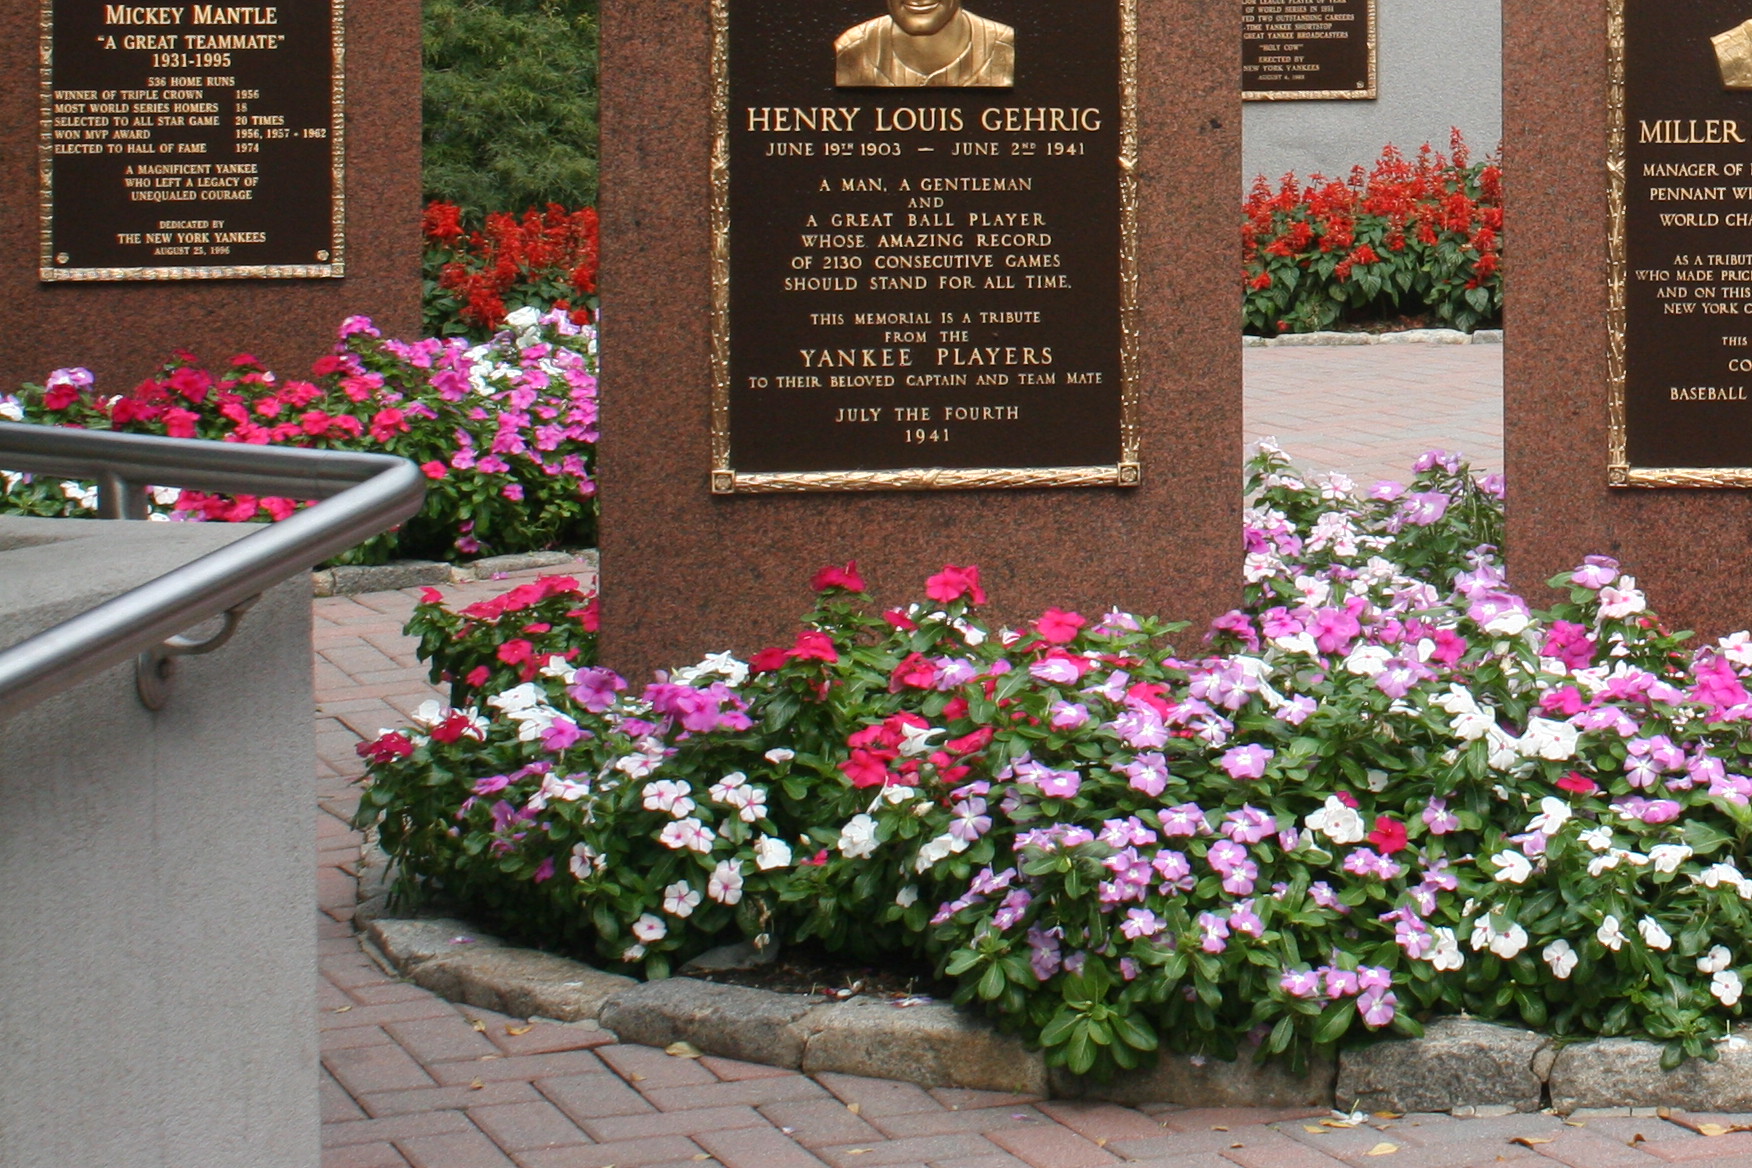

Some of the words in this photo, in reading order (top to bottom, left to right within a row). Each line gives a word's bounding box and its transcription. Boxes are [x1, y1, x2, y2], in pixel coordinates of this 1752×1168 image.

[105, 5, 184, 24] MICKEY
[193, 5, 277, 24] MANTLE
[124, 35, 177, 49] GREAT
[153, 53, 231, 67] 1931-1995
[148, 77, 166, 86] 536
[171, 77, 202, 86] HOME
[206, 77, 235, 86] RUNS
[748, 108, 860, 131] HENRY
[876, 108, 963, 131] LOUIS
[982, 108, 1100, 131] GEHRIG
[1640, 120, 1745, 143] MILLER
[125, 166, 133, 174] A
[138, 164, 211, 174] MAGNIFICENT
[216, 164, 257, 173] YANKEE
[1644, 164, 1719, 176] MANAGER
[1724, 164, 1743, 176] OF
[820, 180, 830, 191] A
[842, 178, 886, 191] MAN,
[899, 179, 910, 191] A
[921, 178, 1031, 191] GENTLEMAN
[908, 197, 943, 208] AND
[806, 215, 817, 227] A
[832, 213, 893, 226] GREAT
[908, 213, 954, 226] BALL
[970, 213, 1045, 226] PLAYER
[117, 233, 141, 244] THE
[146, 233, 172, 243] NEW
[177, 233, 209, 243] YORK
[214, 232, 266, 243] YANKEES
[802, 234, 864, 248] WHOSE
[878, 234, 962, 247] AMAZING
[977, 233, 1051, 246] RECORD
[792, 256, 812, 269] OF
[823, 256, 862, 269] 2130
[875, 255, 993, 269] CONSECUTIVE
[1006, 254, 1060, 267] GAMES
[800, 349, 912, 367] YANKEE
[938, 348, 1052, 365] PLAYERS
[1671, 387, 1746, 400] BASEBALL
[836, 408, 881, 422] JULY
[894, 408, 930, 421] THE
[945, 406, 1018, 420] FOURTH
[906, 429, 948, 444] 1941
